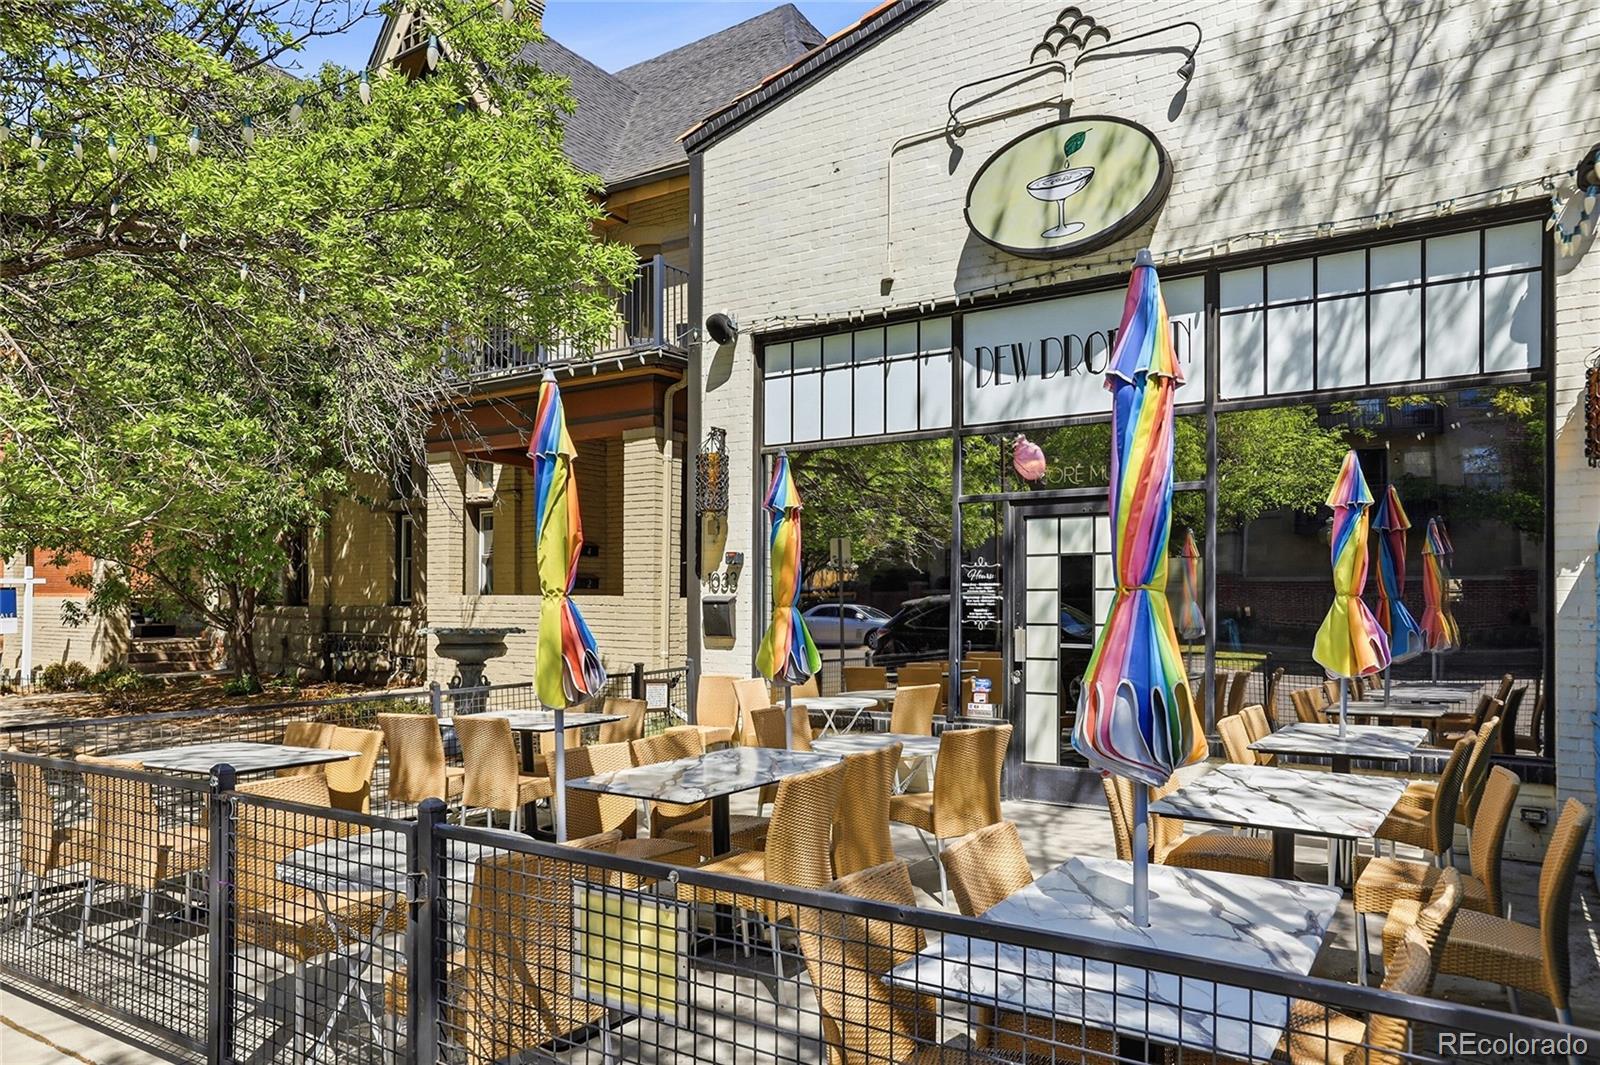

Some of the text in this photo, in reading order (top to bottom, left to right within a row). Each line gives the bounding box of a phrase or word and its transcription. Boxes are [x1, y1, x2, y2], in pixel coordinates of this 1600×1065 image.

[974, 341, 1032, 388] DEW
[1170, 317, 1192, 364] N
[707, 571, 738, 593] 1033
